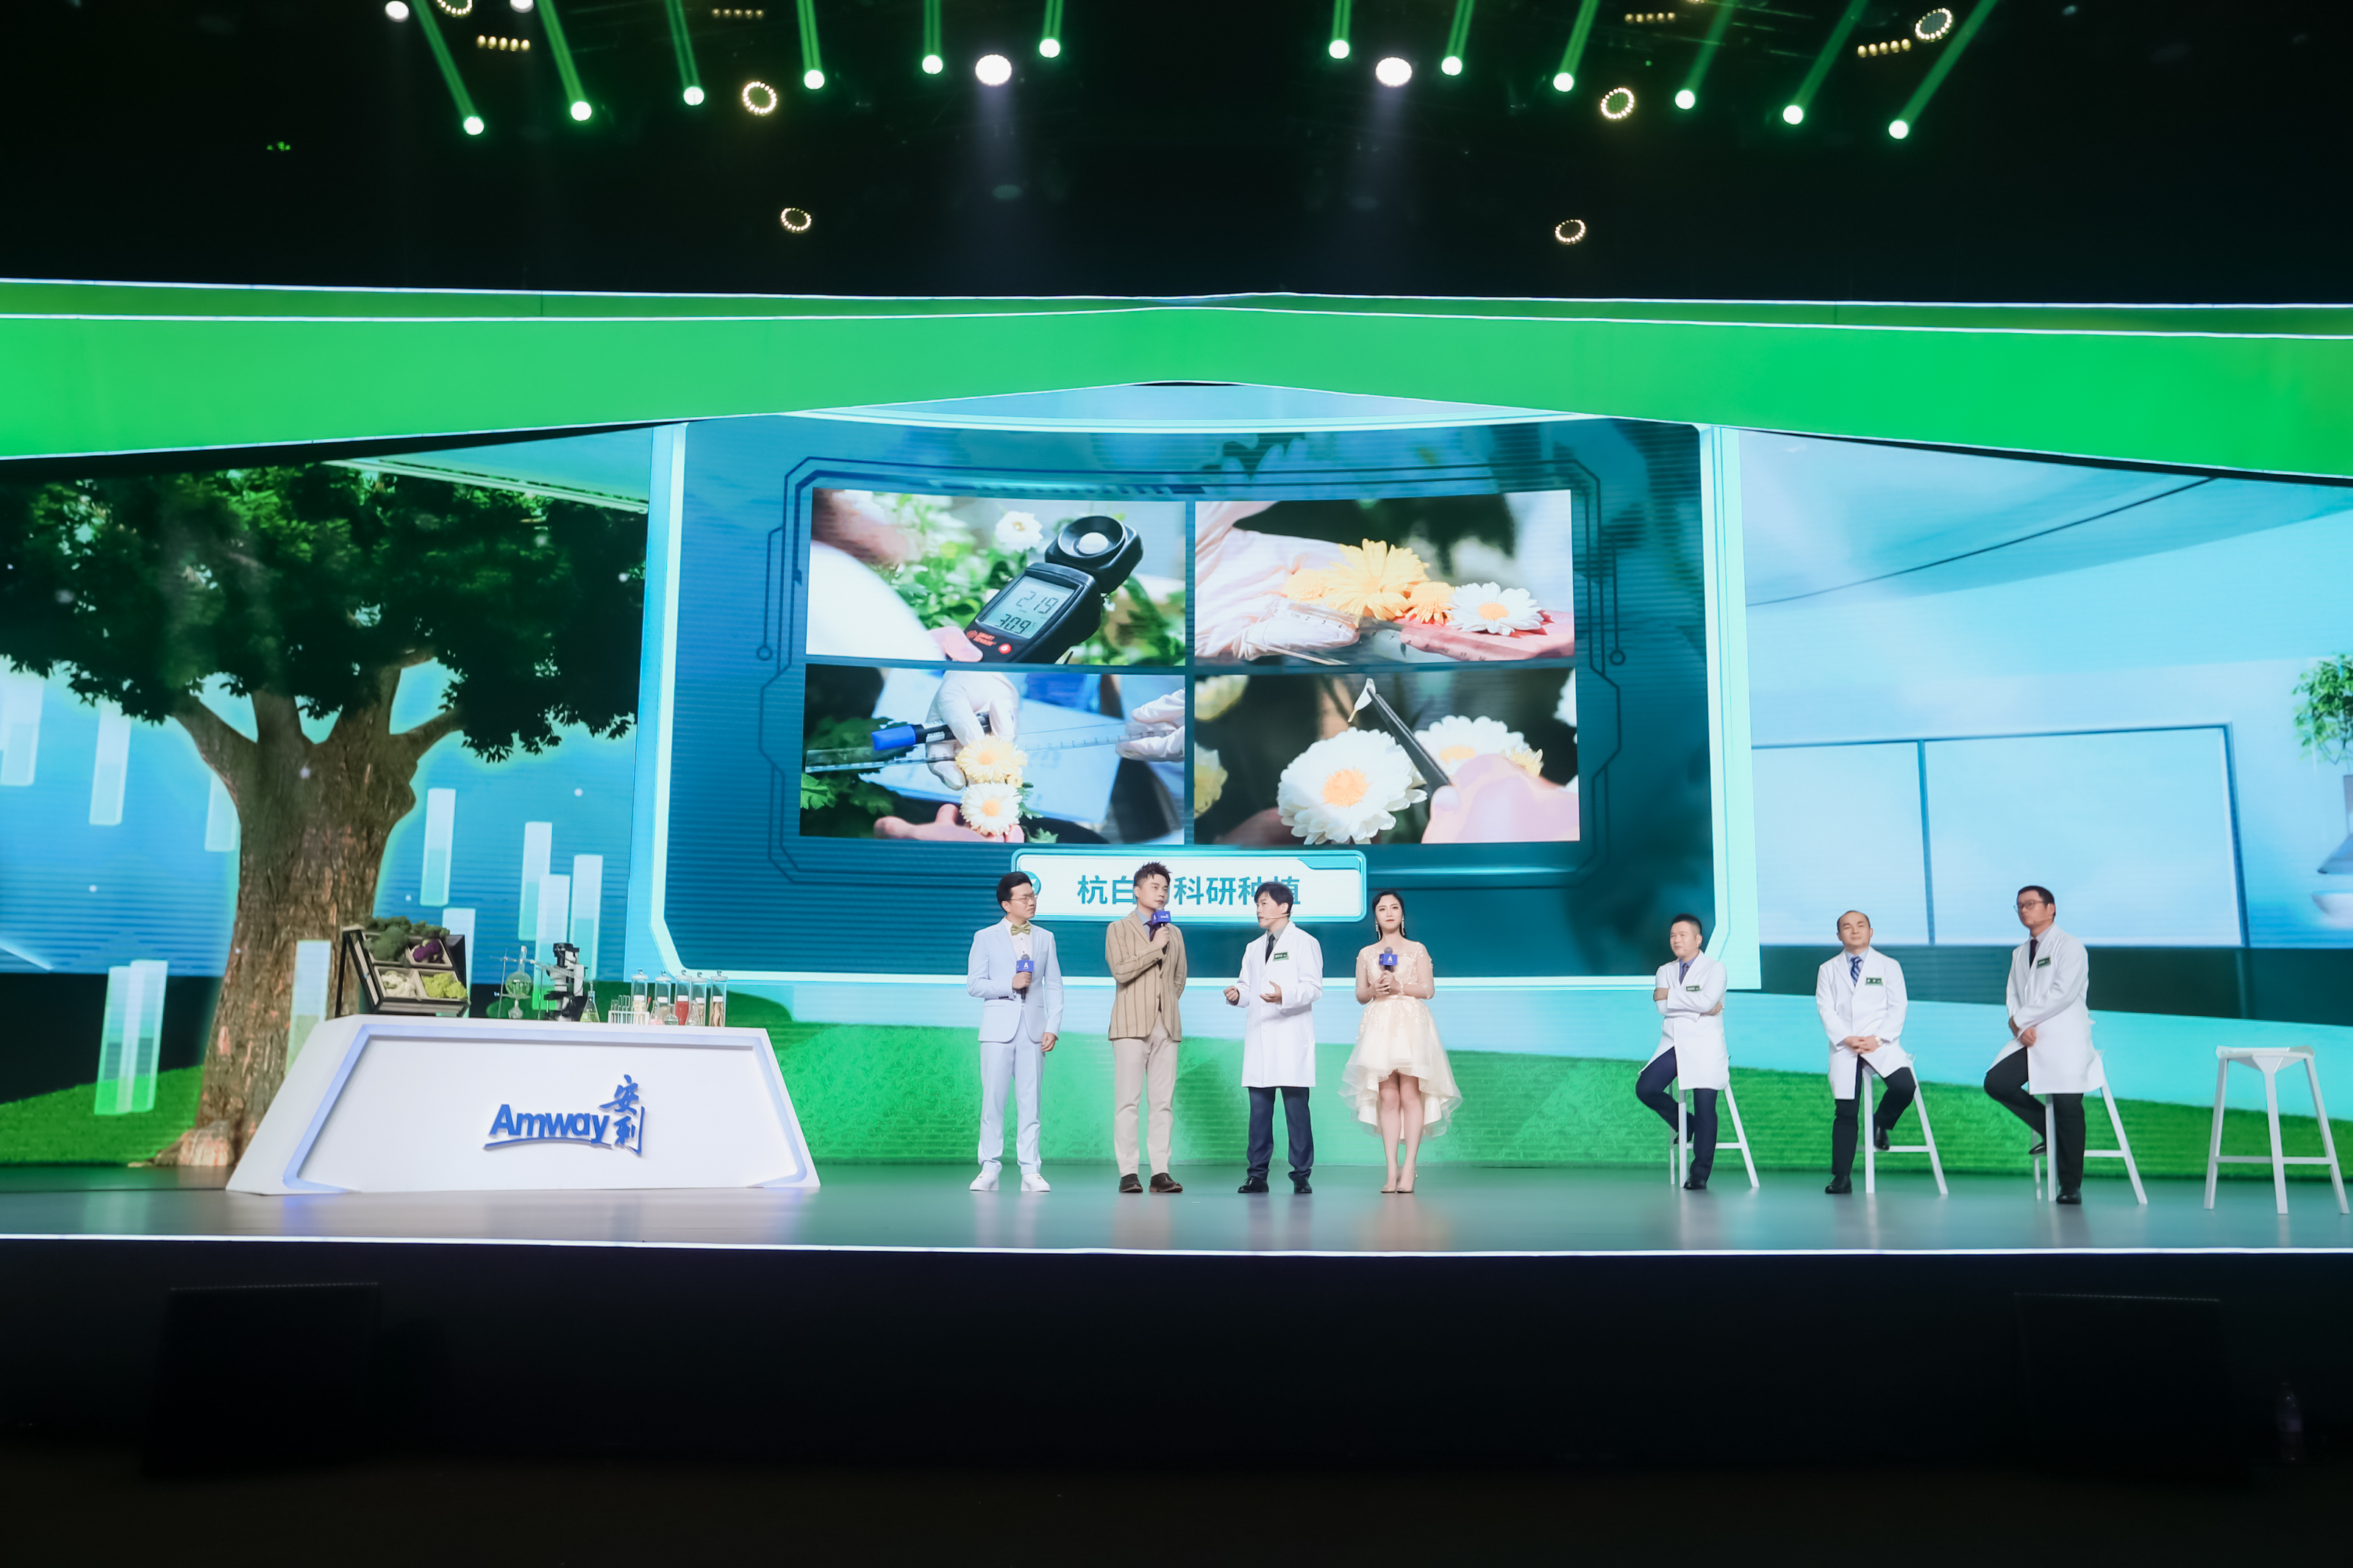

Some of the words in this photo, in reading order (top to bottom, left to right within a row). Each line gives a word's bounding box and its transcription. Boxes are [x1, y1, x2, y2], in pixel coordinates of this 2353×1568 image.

[1077, 875, 1301, 905] 杭白科研种
[488, 1103, 610, 1144] Amway
[599, 1074, 645, 1156] 安利
